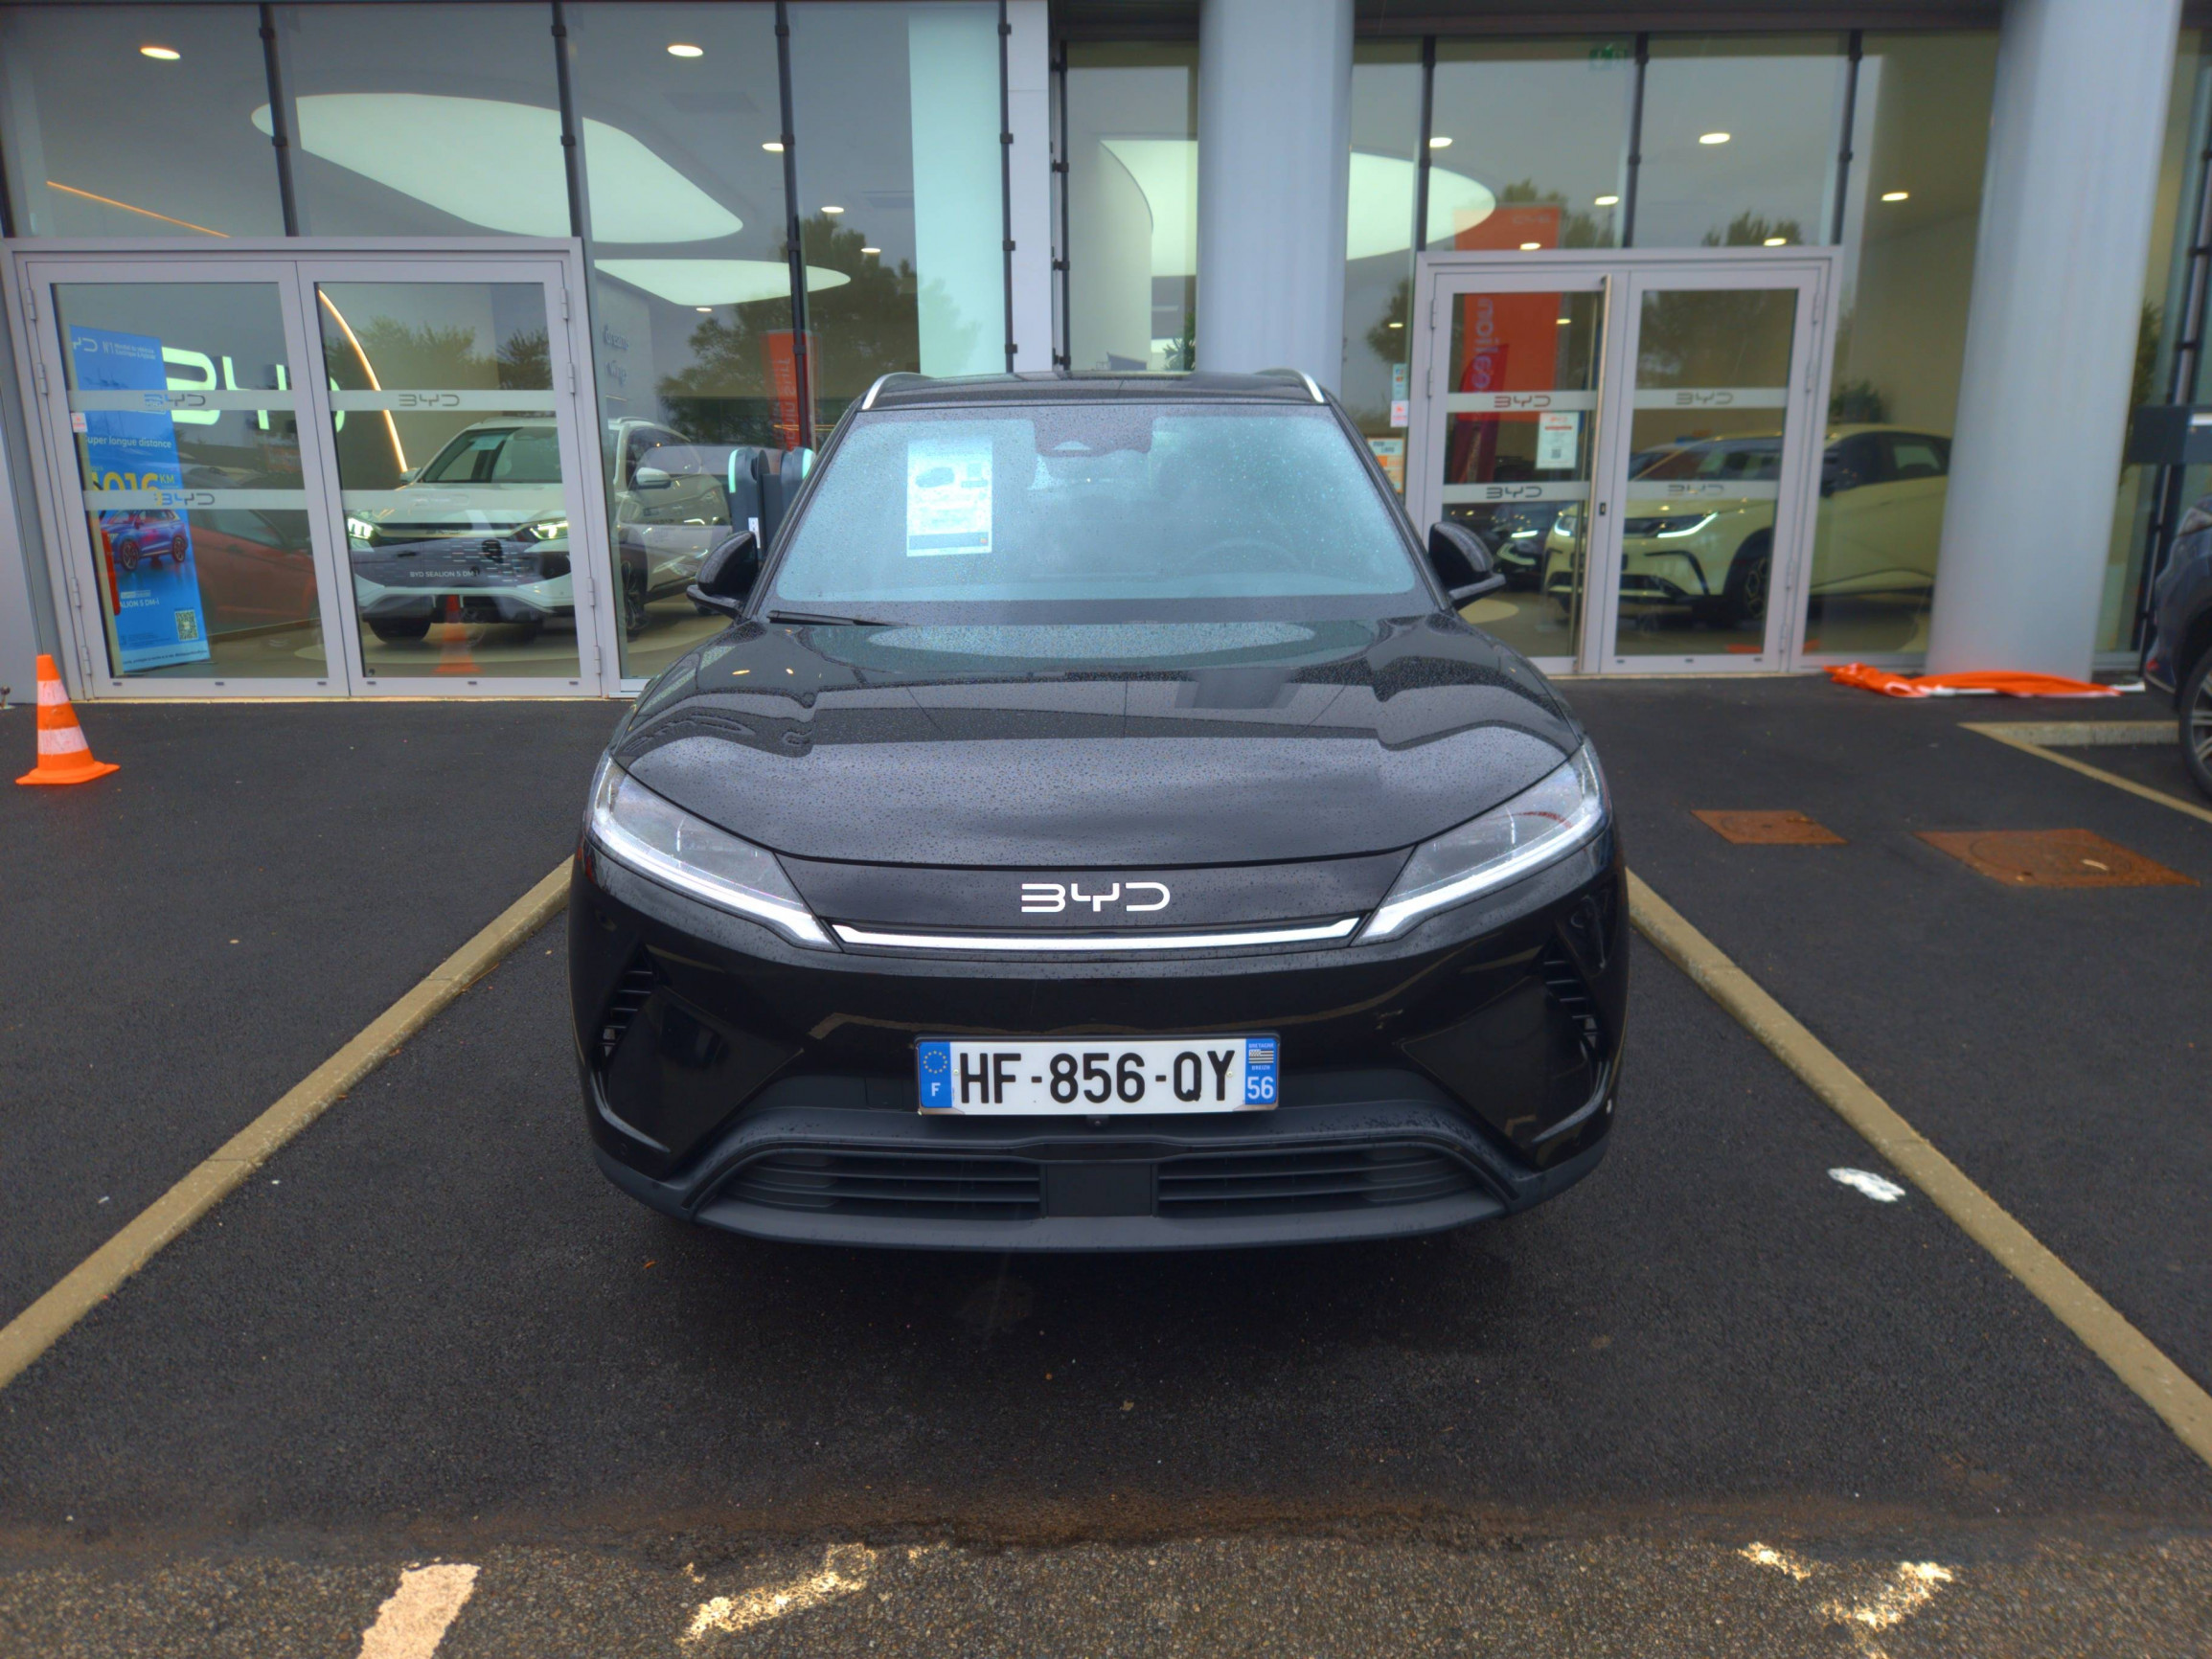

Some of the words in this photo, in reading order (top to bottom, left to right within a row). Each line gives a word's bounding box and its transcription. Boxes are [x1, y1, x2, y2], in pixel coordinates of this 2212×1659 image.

[71, 337, 98, 352] YD
[144, 394, 205, 407] BYD
[399, 394, 460, 407] BYD
[1494, 395, 1551, 408] BYD
[1676, 392, 1734, 405] BYD
[85, 435, 106, 447] uper
[109, 436, 137, 447] longue
[139, 437, 172, 448] distance
[160, 473, 174, 484] KM
[1486, 487, 1542, 499] BYD
[1668, 484, 1723, 497] BYD
[154, 492, 215, 506] BYD
[1021, 881, 1171, 913] BYD
[931, 1082, 941, 1097] F
[960, 1050, 1235, 1103] HF-856-QY
[1247, 1076, 1274, 1100] 56
